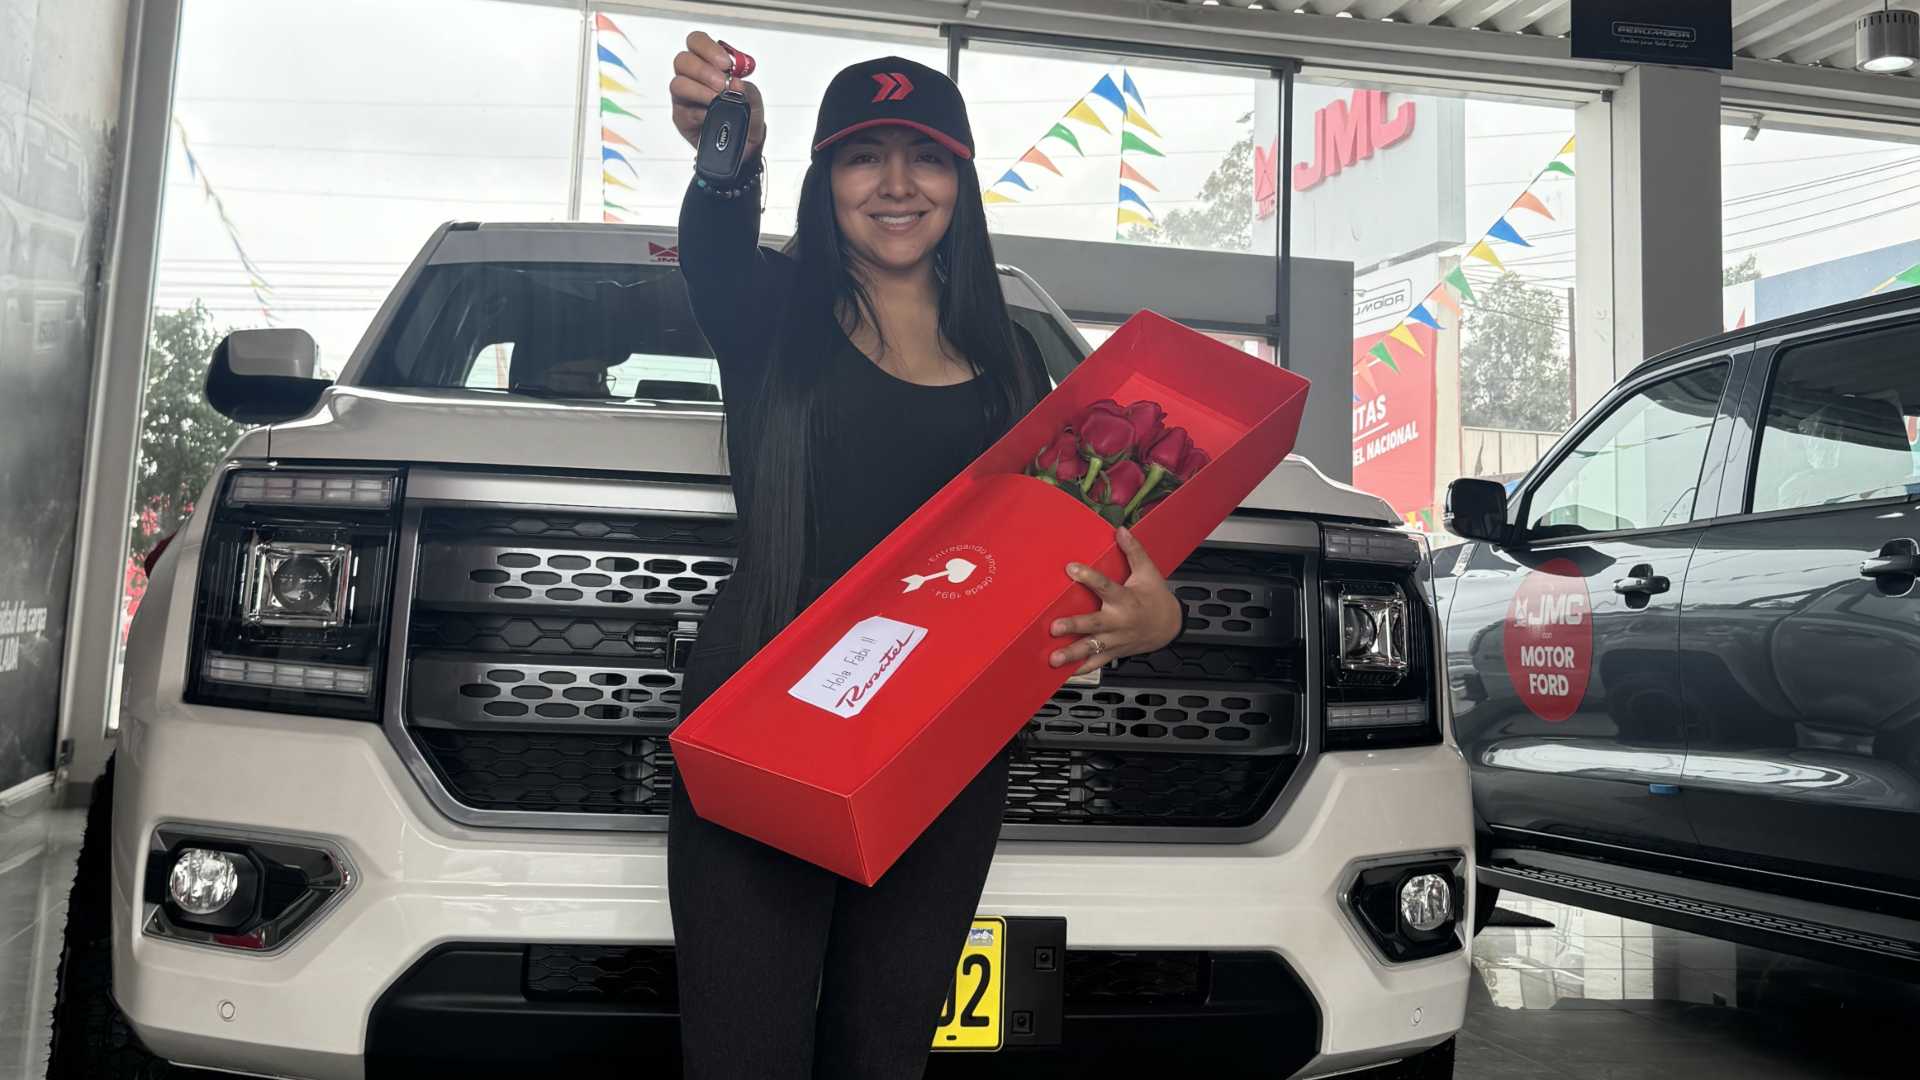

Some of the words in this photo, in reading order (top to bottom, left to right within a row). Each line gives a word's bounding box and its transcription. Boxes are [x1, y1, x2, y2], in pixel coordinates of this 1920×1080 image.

[1293, 89, 1416, 192] JMC
[1366, 421, 1419, 461] NACIONAL
[1528, 593, 1584, 625] JMC
[822, 671, 852, 692] Hola
[843, 648, 871, 666] Fabi
[834, 629, 915, 708] Rosatel
[1520, 646, 1575, 668] MOTOR
[1528, 673, 1569, 697] FORD
